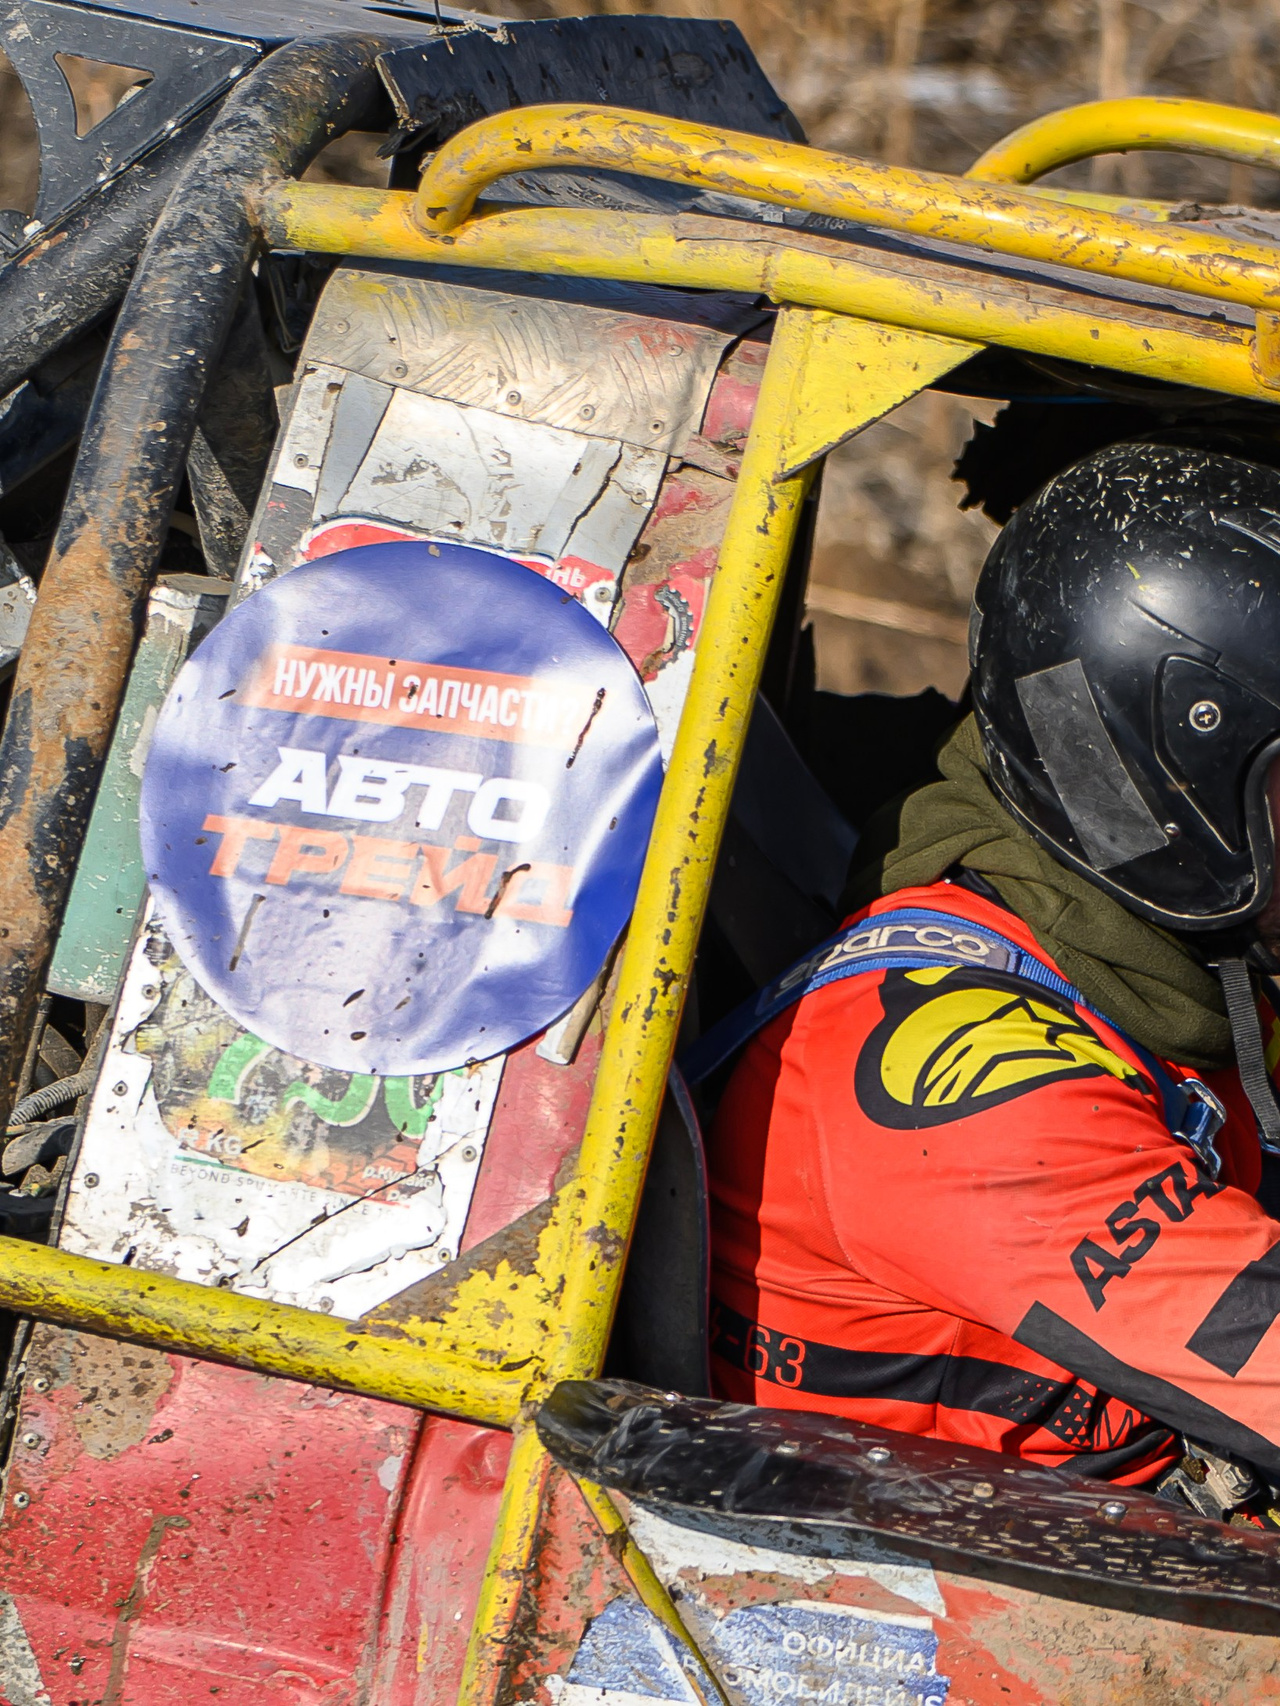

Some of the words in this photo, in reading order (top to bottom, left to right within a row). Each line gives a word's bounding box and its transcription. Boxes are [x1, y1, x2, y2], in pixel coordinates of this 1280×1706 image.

[272, 658, 396, 709] НУЖНЫ
[398, 674, 580, 736] ЗАПЧАСТИ?
[247, 746, 551, 844] АВТО
[202, 814, 575, 928] ТРЕЙД
[170, 1163, 231, 1184] BEYOND
